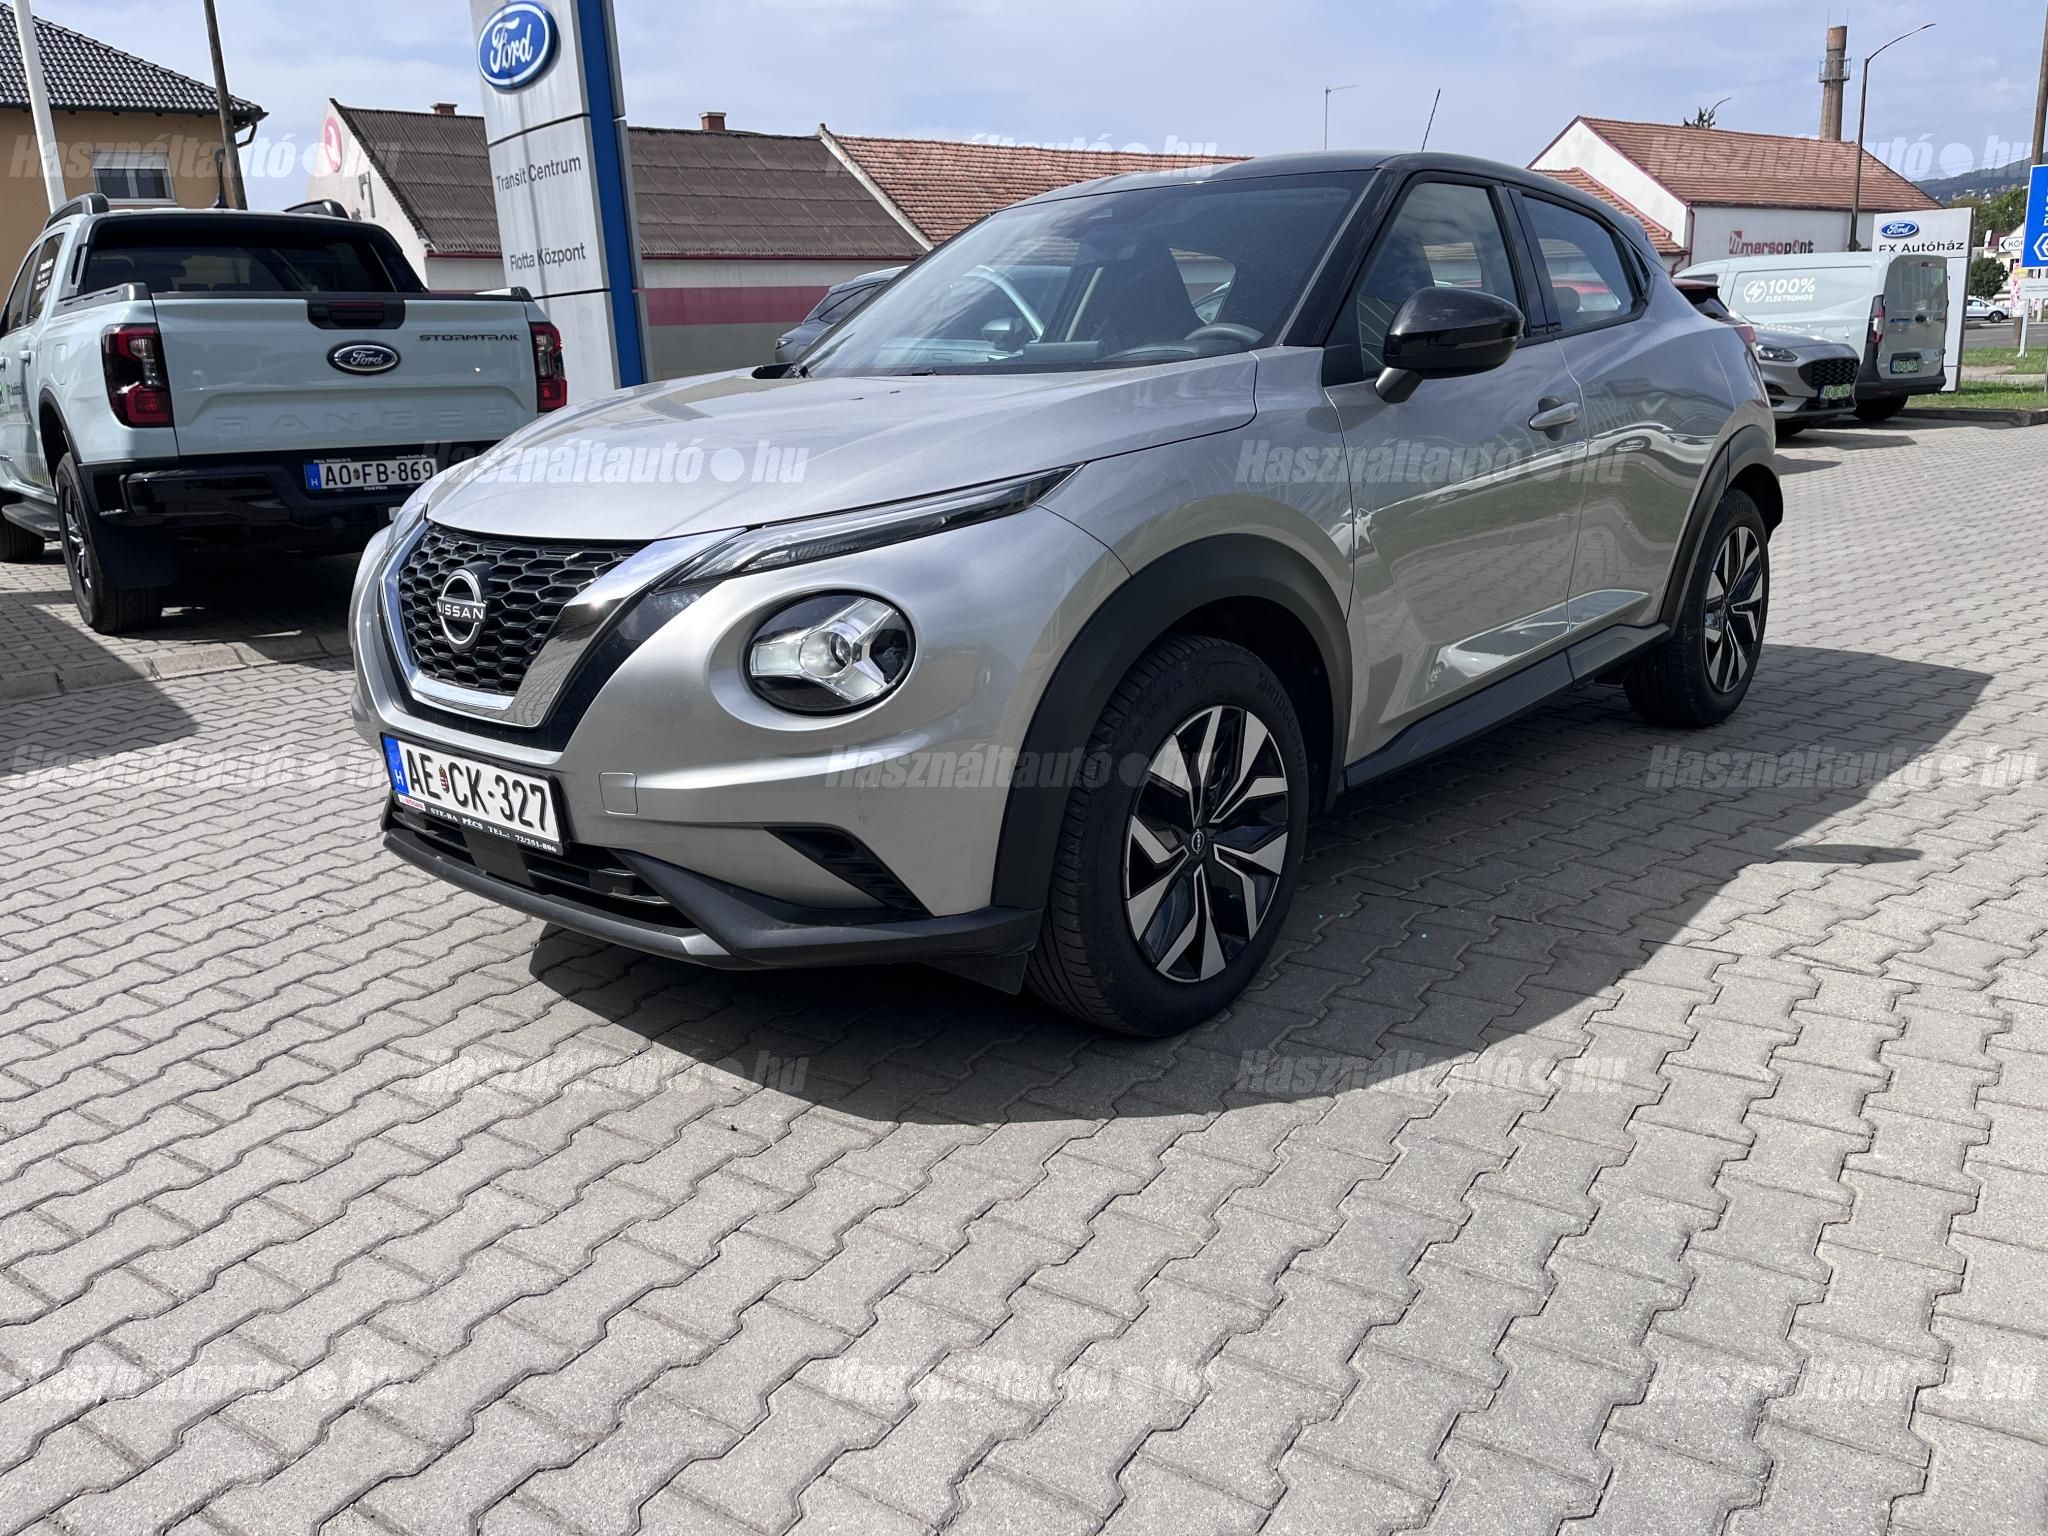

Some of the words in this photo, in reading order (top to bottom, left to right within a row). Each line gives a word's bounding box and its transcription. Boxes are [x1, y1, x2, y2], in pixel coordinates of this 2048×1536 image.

[489, 17, 533, 73] Ford
[496, 170, 528, 192] Transit
[528, 155, 582, 182] Centrum
[1887, 223, 1911, 235] Ford
[1901, 239, 1964, 252] Autóház
[510, 251, 536, 271] Flotta
[537, 242, 586, 268] Központ
[1768, 277, 1815, 294] 100%
[1765, 294, 1813, 303] ELEKTROMOS
[419, 334, 520, 342] STORMTRAK
[350, 350, 384, 365] Ford
[311, 478, 319, 486] H
[437, 601, 484, 620] NISSAN
[394, 771, 404, 786] H
